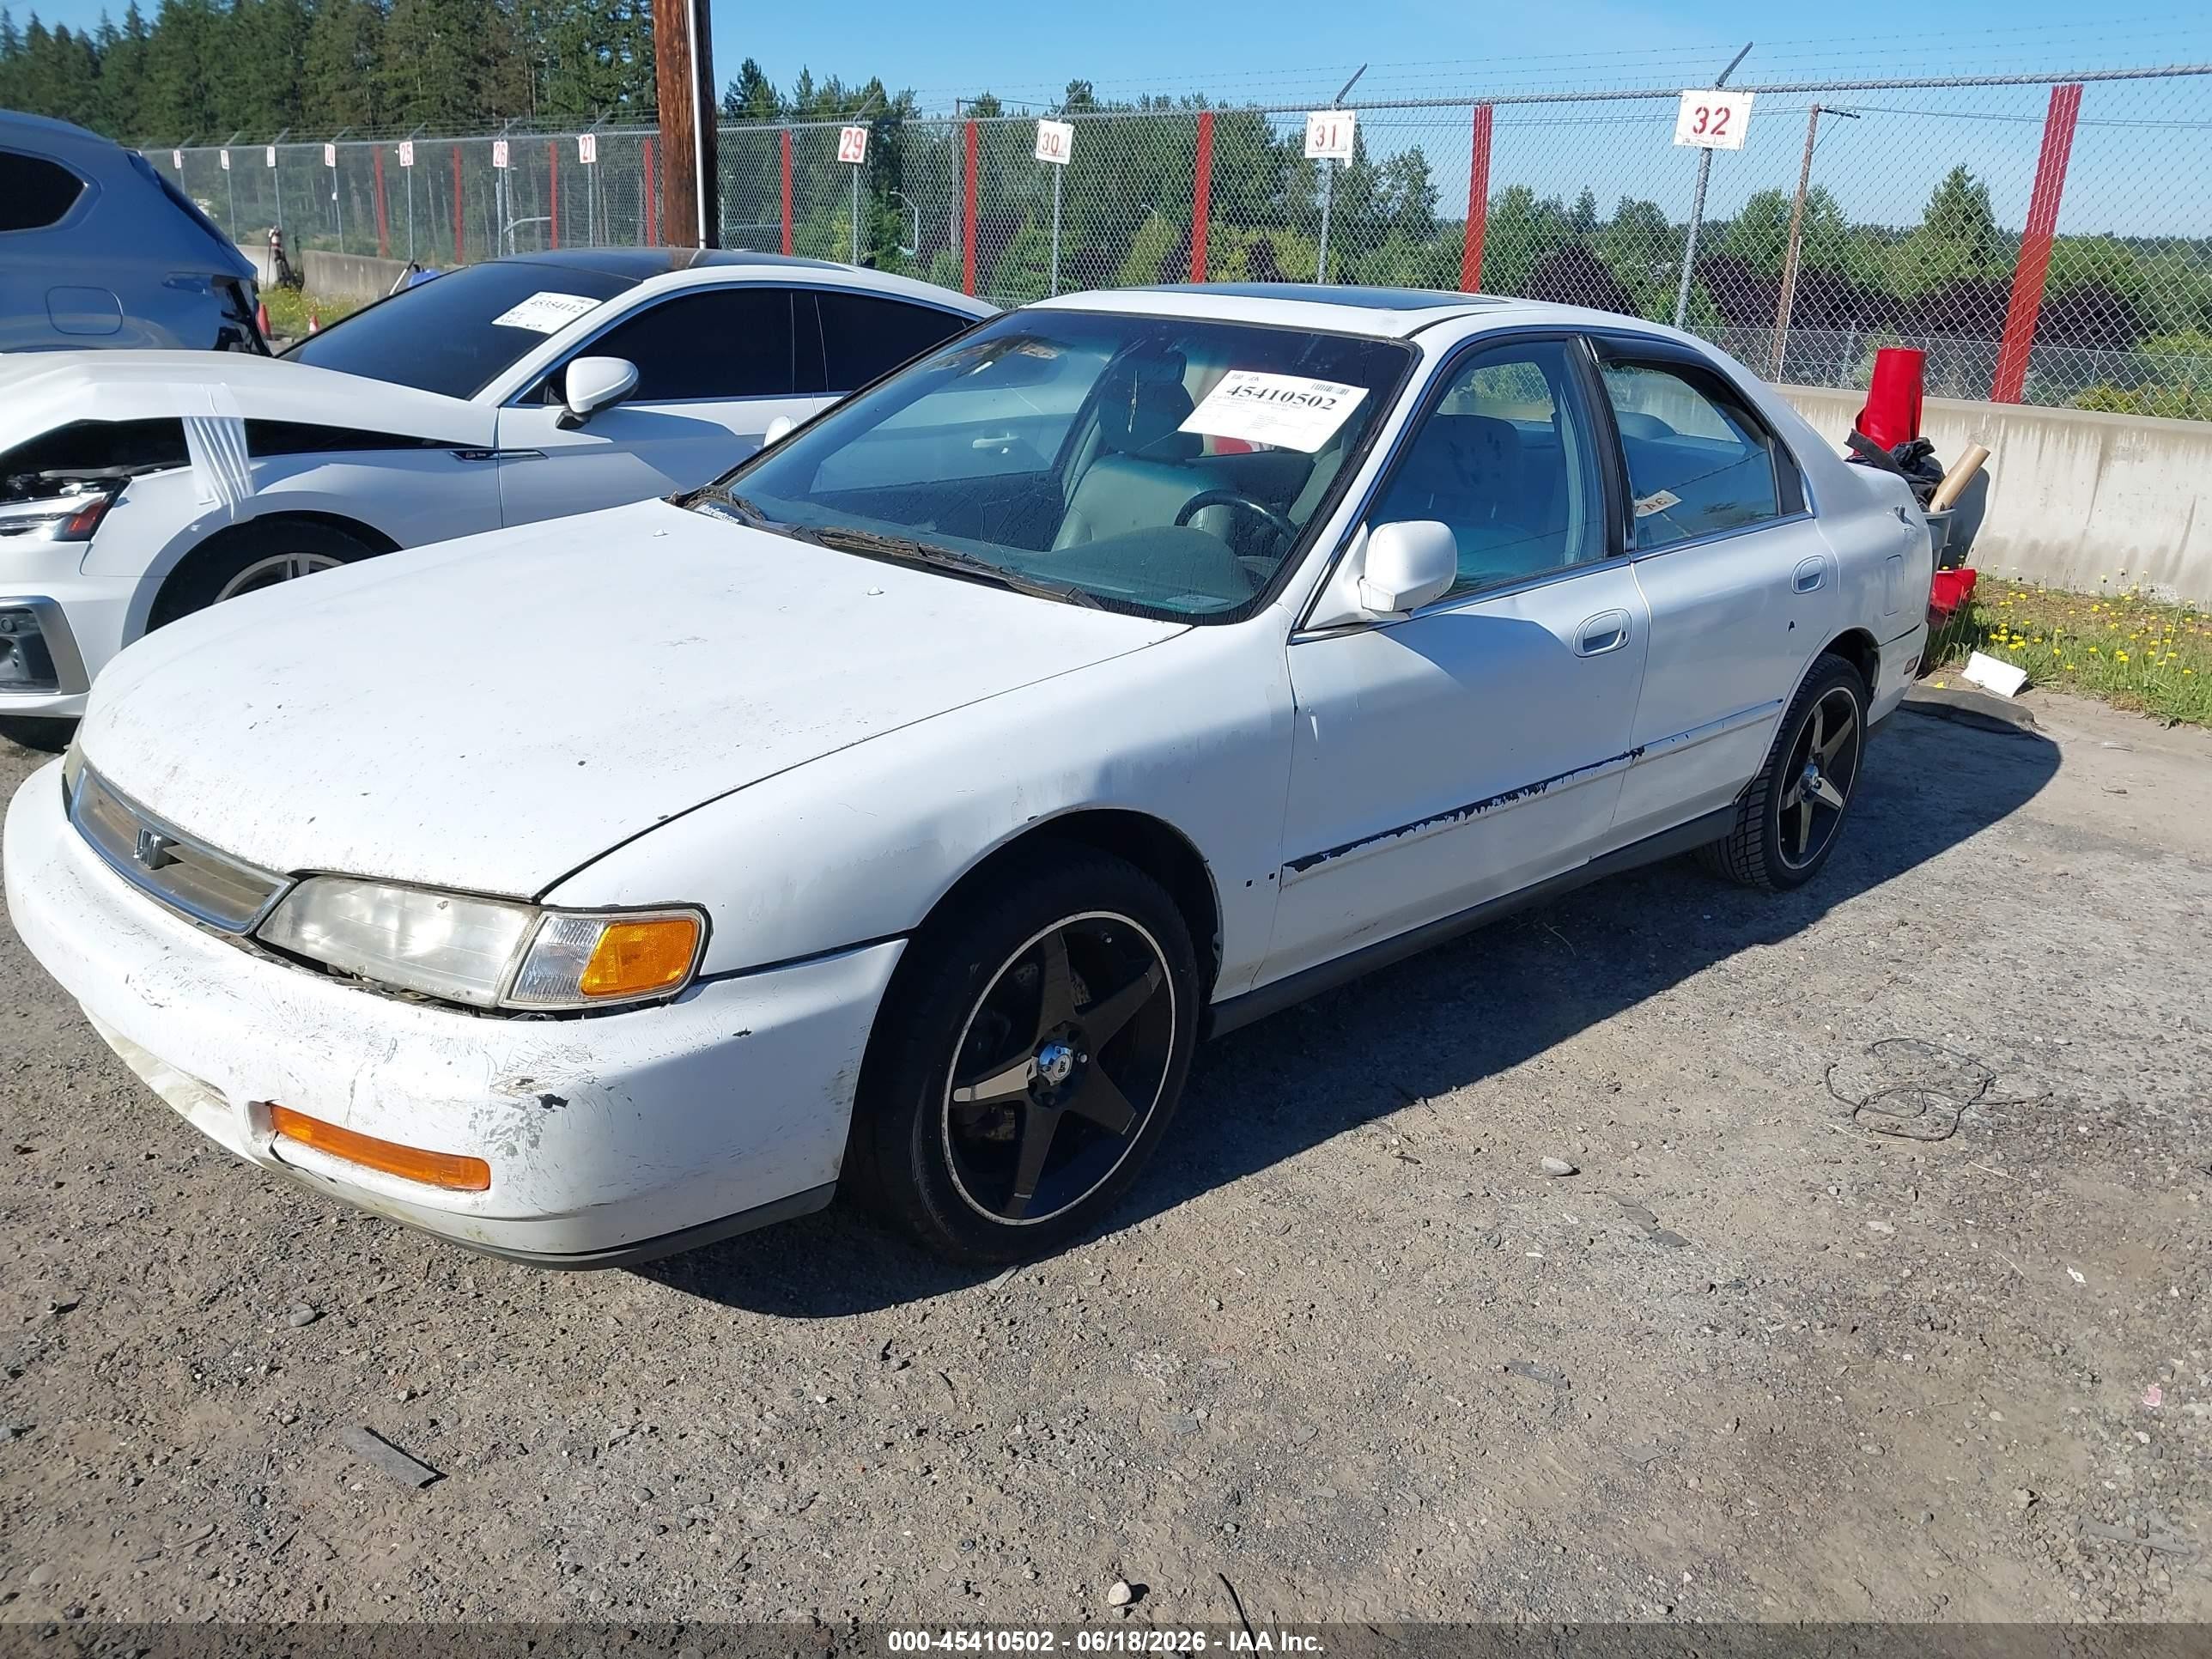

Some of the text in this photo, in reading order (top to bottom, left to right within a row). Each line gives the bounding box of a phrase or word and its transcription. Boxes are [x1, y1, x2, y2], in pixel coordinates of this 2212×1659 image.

[1692, 106, 1731, 136] 32
[842, 130, 864, 159] 29
[1042, 131, 1060, 155] 30
[1316, 124, 1337, 148] 31
[401, 143, 412, 164] 25
[495, 143, 506, 164] 26
[581, 137, 592, 161] 27
[1226, 385, 1337, 410] 45410502
